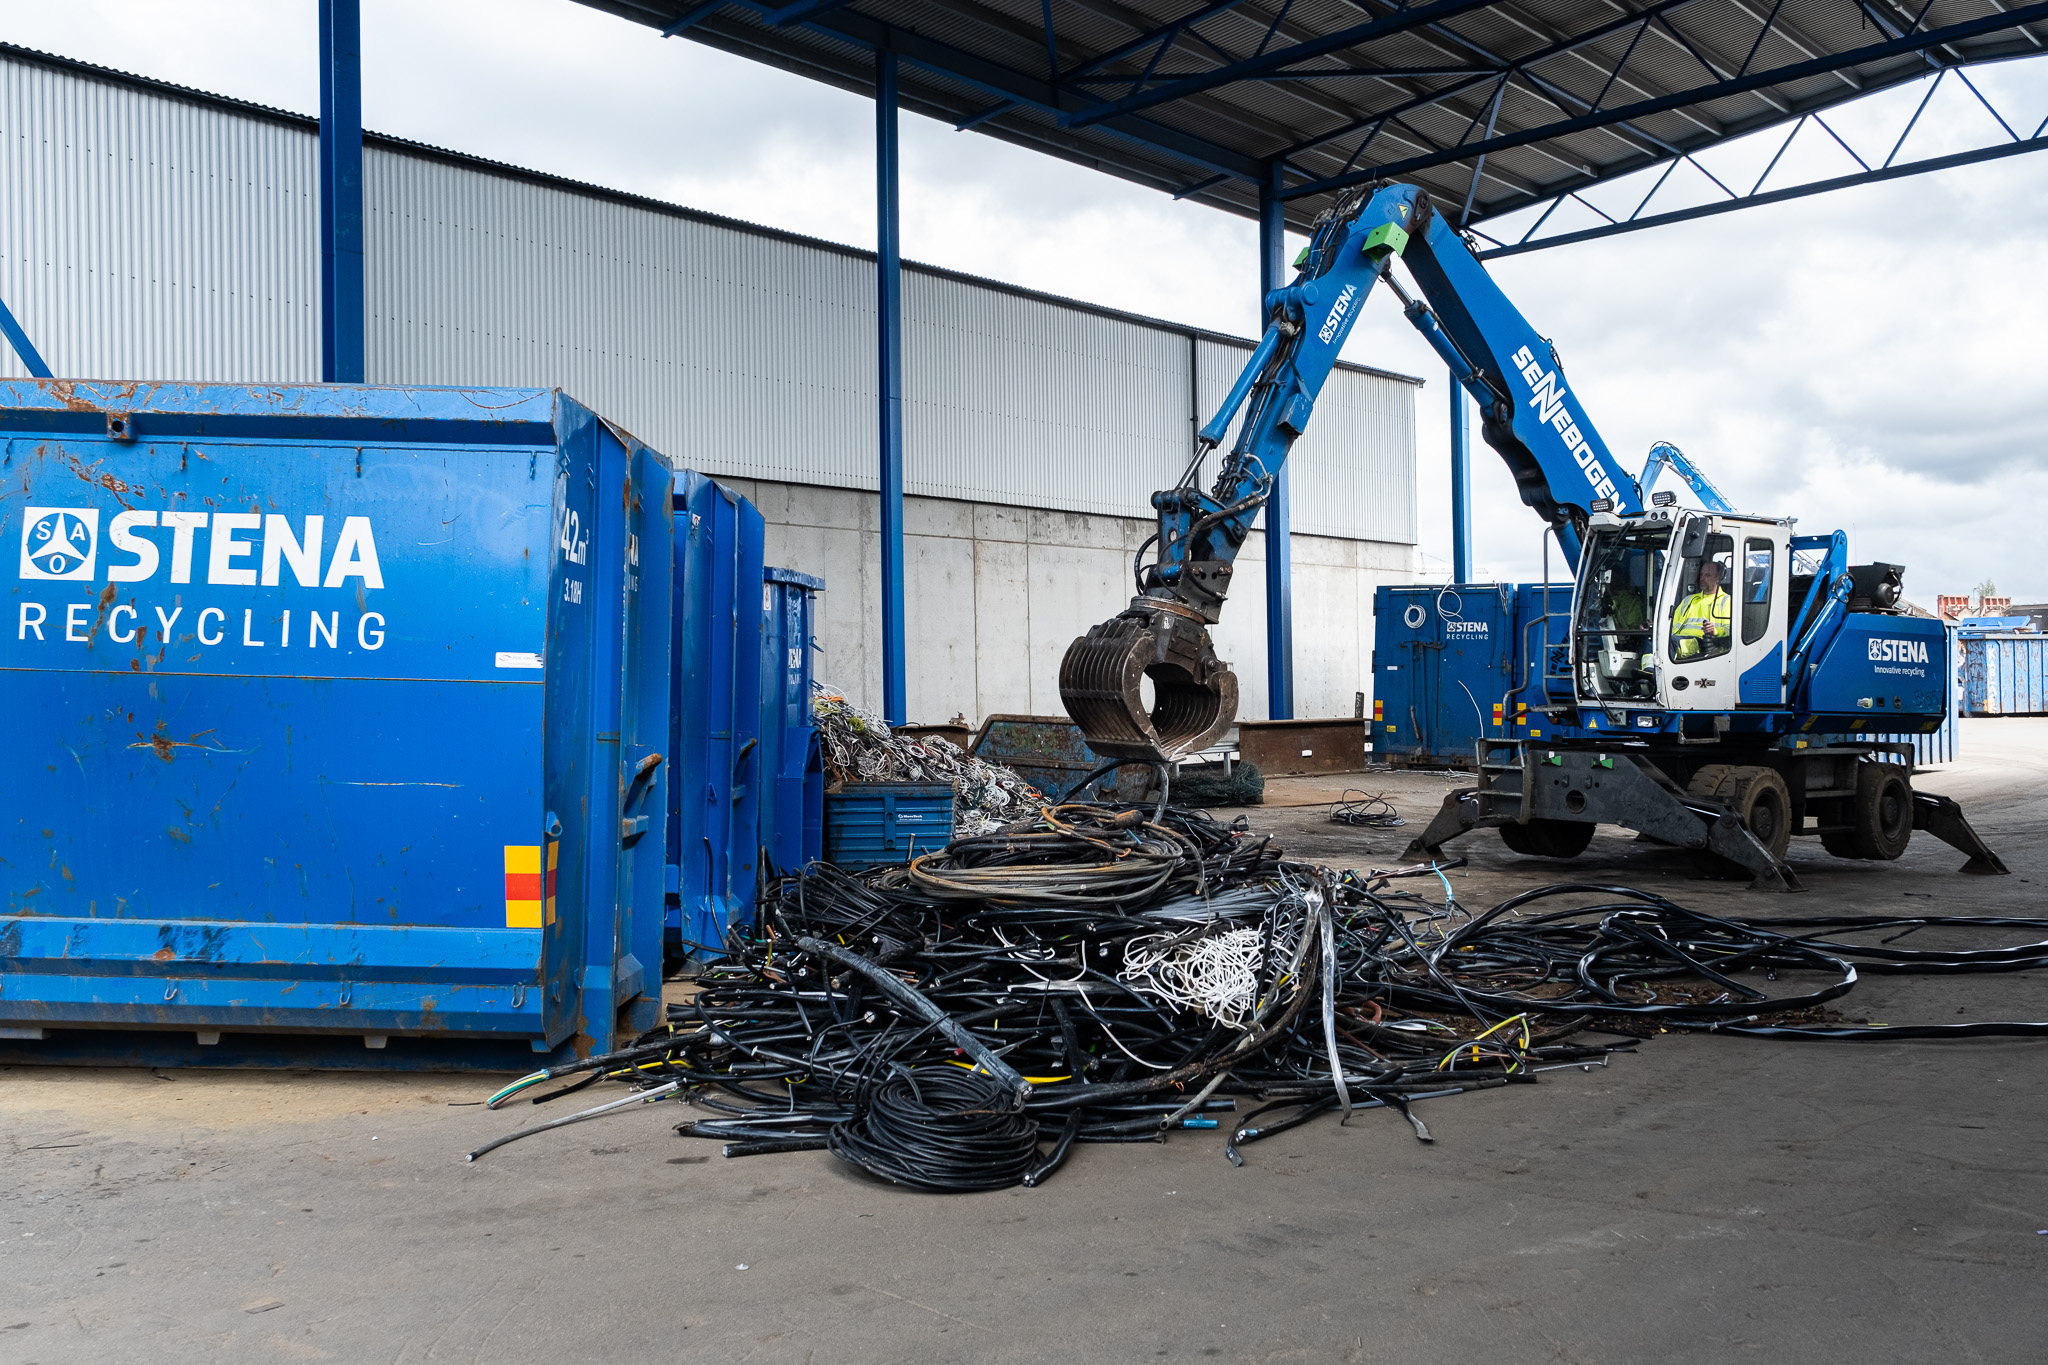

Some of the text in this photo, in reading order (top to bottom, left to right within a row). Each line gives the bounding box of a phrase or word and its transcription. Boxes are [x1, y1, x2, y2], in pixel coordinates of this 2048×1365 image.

[1325, 284, 1358, 332] STENA
[1511, 345, 1627, 514] SENNEBOGEN
[107, 510, 385, 590] STENA
[18, 602, 386, 651] RECYCLING
[1446, 633, 1489, 641] RECYCLING
[1456, 621, 1489, 633] STENA
[1882, 639, 1930, 664] STENA
[1874, 665, 1926, 678] Innovative recycling
